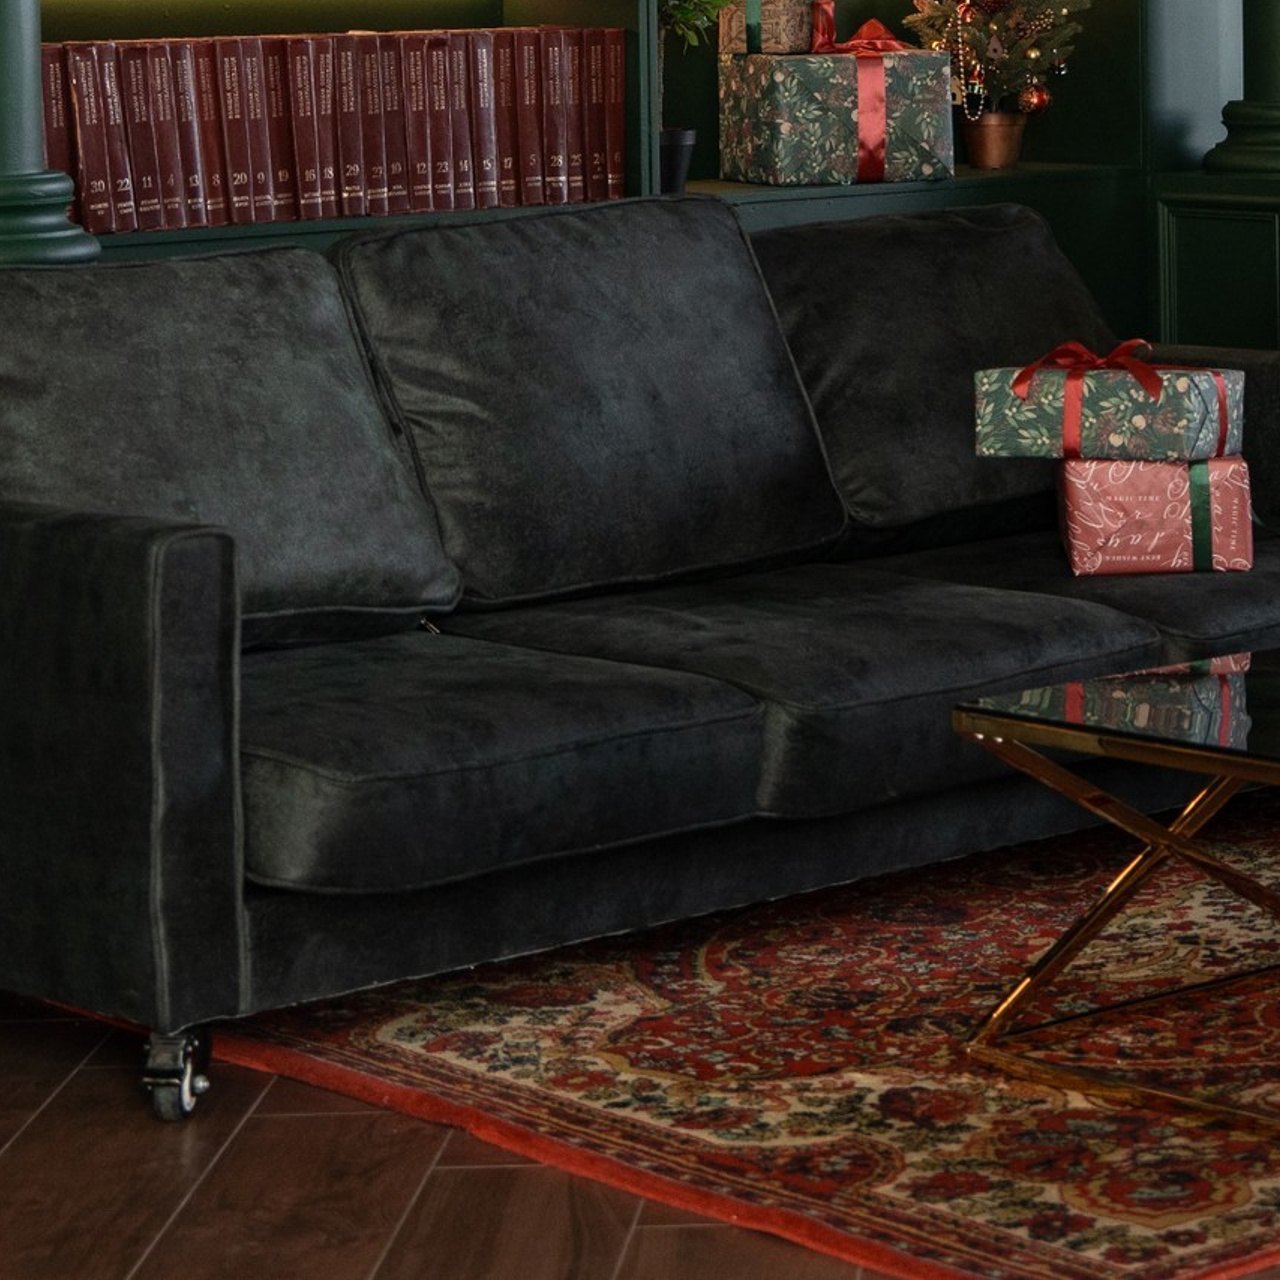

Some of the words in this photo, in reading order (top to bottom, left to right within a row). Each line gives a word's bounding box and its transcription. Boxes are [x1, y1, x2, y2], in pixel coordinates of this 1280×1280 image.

[504, 157, 513, 169] 17
[529, 155, 536, 166] 5
[550, 155, 563, 167] 28
[323, 166, 334, 179] 18
[346, 164, 359, 177] 29
[416, 162, 427, 174] 12
[437, 162, 449, 173] 23
[189, 174, 200, 187] 13
[212, 174, 221, 186] 8
[233, 172, 247, 185] 20
[257, 172, 265, 184] 9
[278, 170, 289, 182] 19
[304, 169, 316, 182] 16
[91, 180, 105, 193] 30
[117, 178, 131, 191] 22
[142, 176, 152, 188] 11
